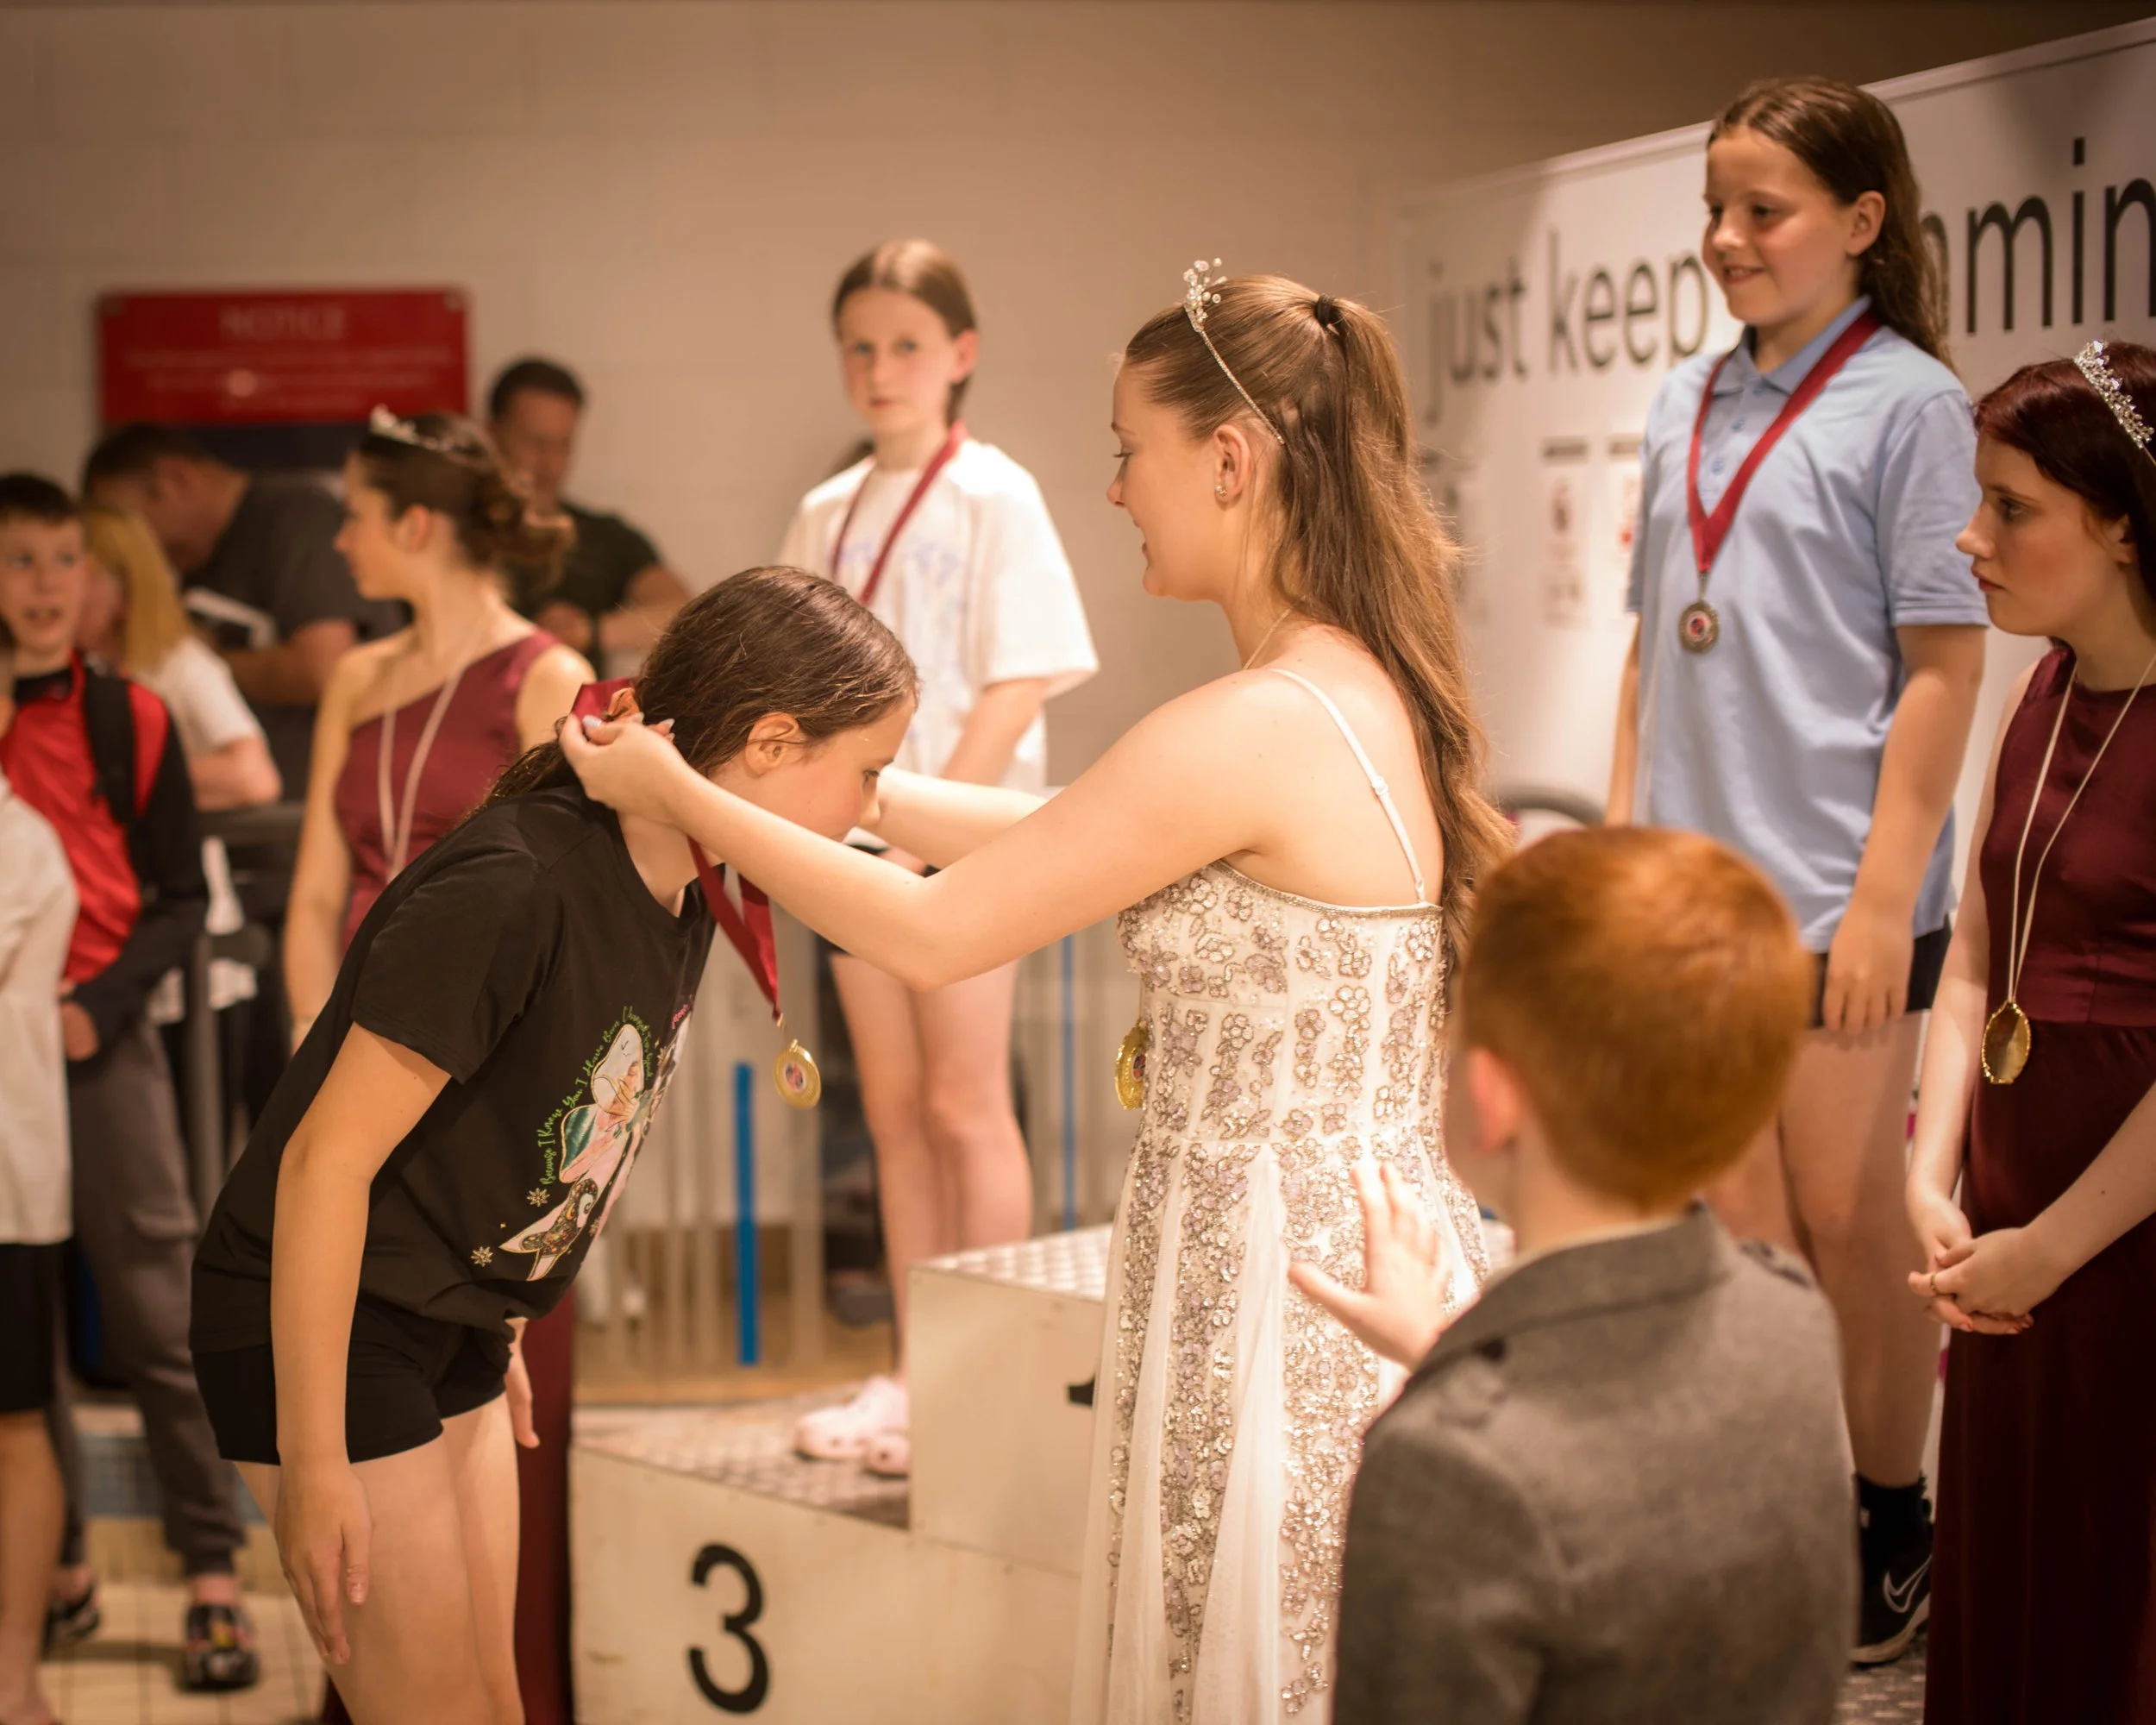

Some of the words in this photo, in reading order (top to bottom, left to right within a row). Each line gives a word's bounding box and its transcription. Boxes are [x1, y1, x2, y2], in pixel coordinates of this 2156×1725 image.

[1424, 256, 1526, 429] just
[1548, 228, 1707, 373] keep
[537, 1138, 556, 1148] I
[539, 1147, 557, 1185] Because
[687, 1540, 771, 1716] 3
